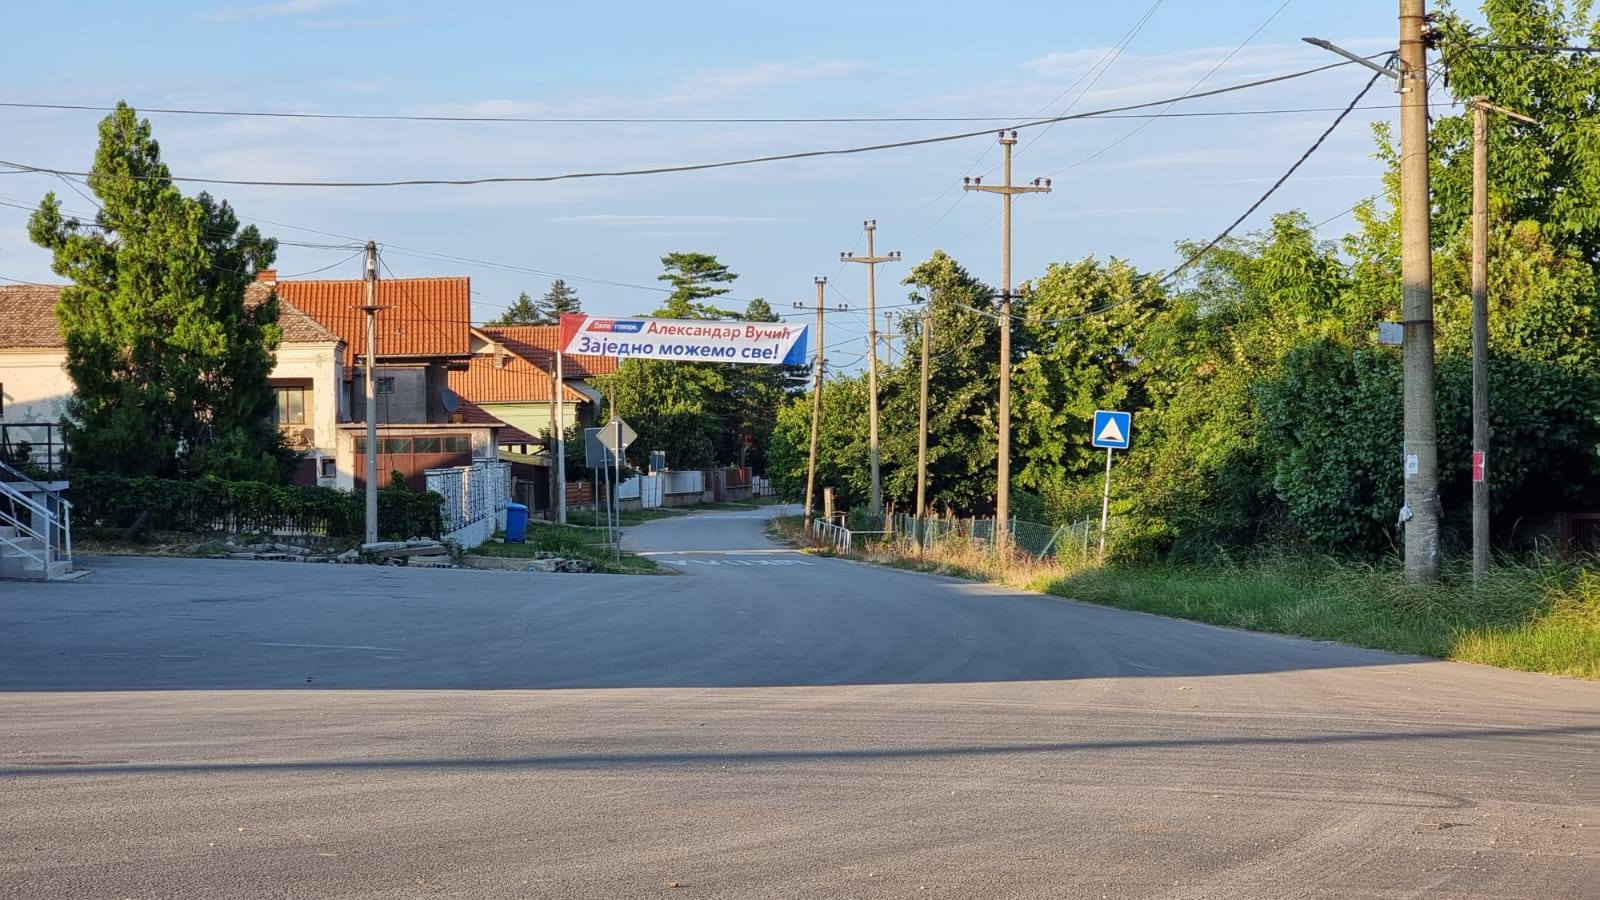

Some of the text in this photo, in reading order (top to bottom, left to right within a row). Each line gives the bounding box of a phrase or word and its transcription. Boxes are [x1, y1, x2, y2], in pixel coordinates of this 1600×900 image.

[647, 322, 791, 342] Александар Вучић
[578, 337, 779, 359] Заједно можемо све!
